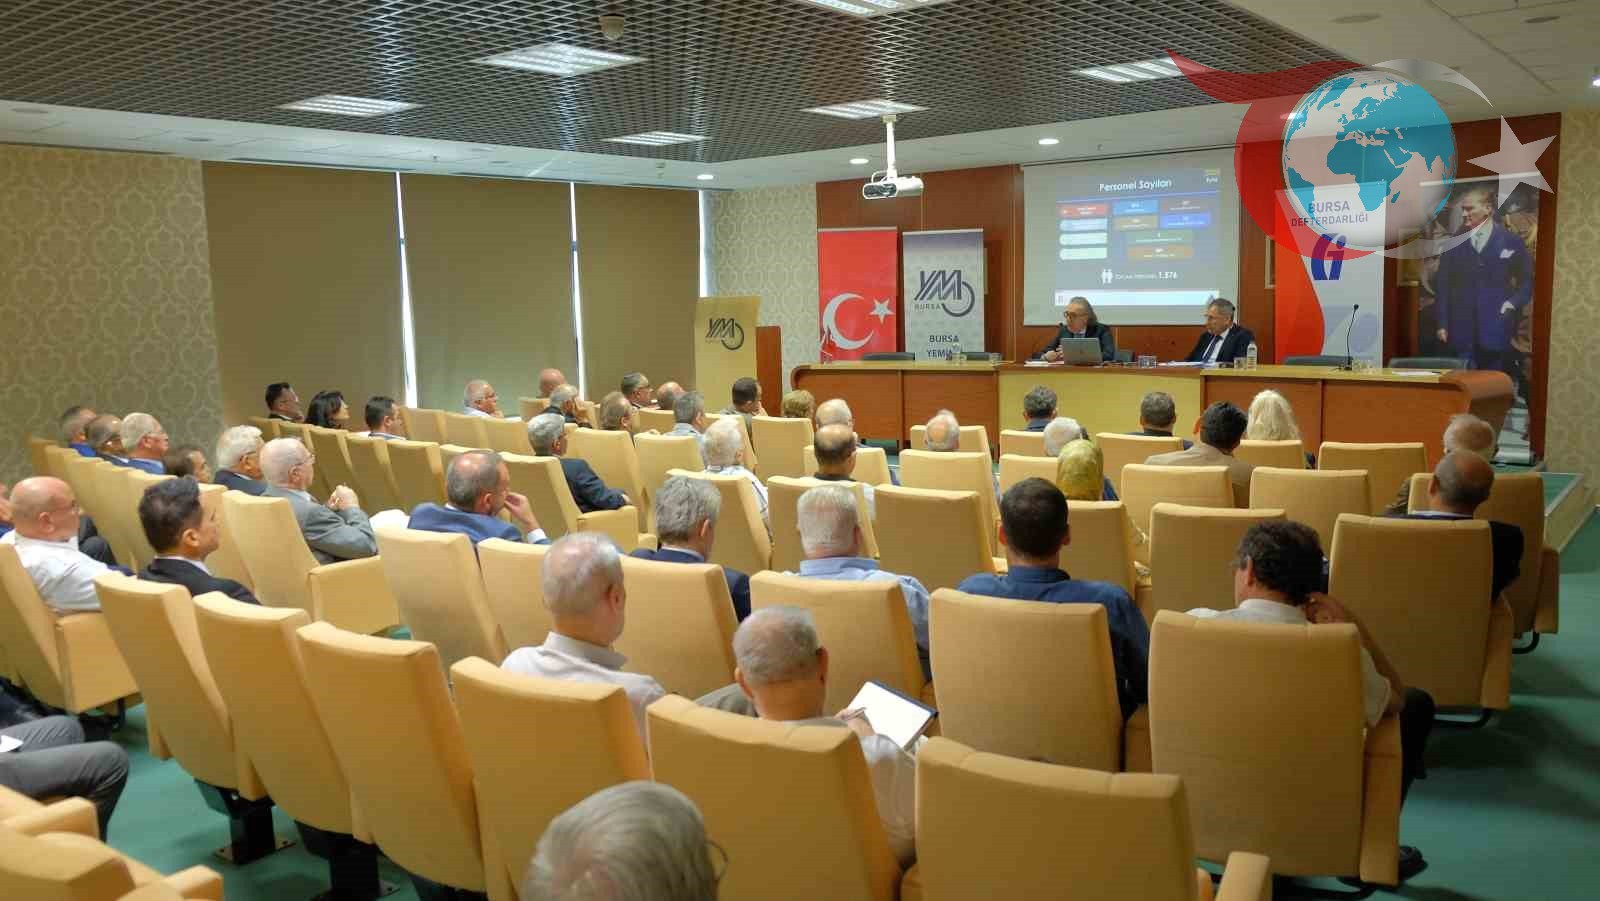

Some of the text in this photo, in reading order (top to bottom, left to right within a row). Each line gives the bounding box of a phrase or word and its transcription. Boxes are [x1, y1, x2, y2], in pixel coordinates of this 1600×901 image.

[1099, 180, 1137, 192] Personel
[1308, 201, 1350, 214] BURSA
[929, 335, 960, 343] BURSA
